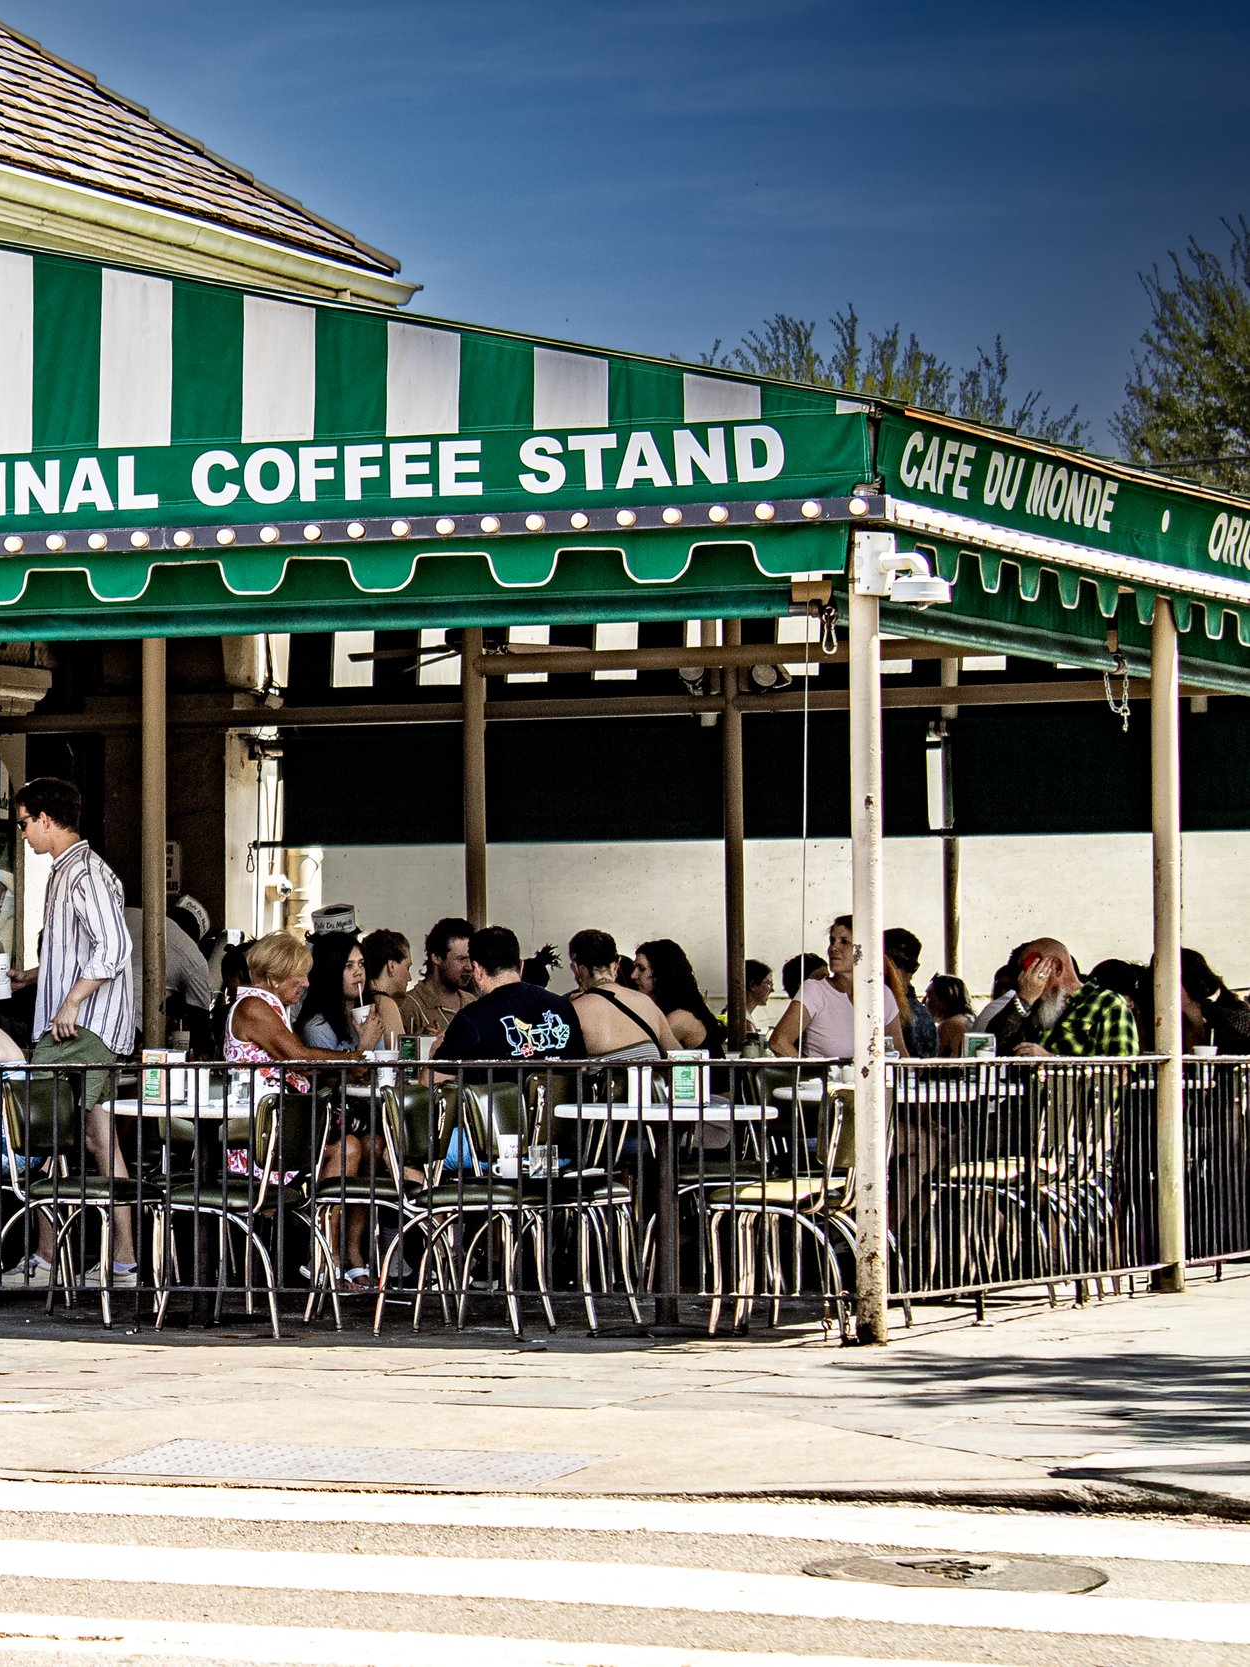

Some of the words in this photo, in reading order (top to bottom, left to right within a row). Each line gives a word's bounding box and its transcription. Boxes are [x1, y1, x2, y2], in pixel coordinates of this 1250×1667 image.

[191, 440, 483, 507] COFFEE
[518, 425, 785, 494] STAND
[900, 431, 977, 500] CAFE
[983, 451, 1026, 511] DU
[1025, 462, 1119, 533] MONDE
